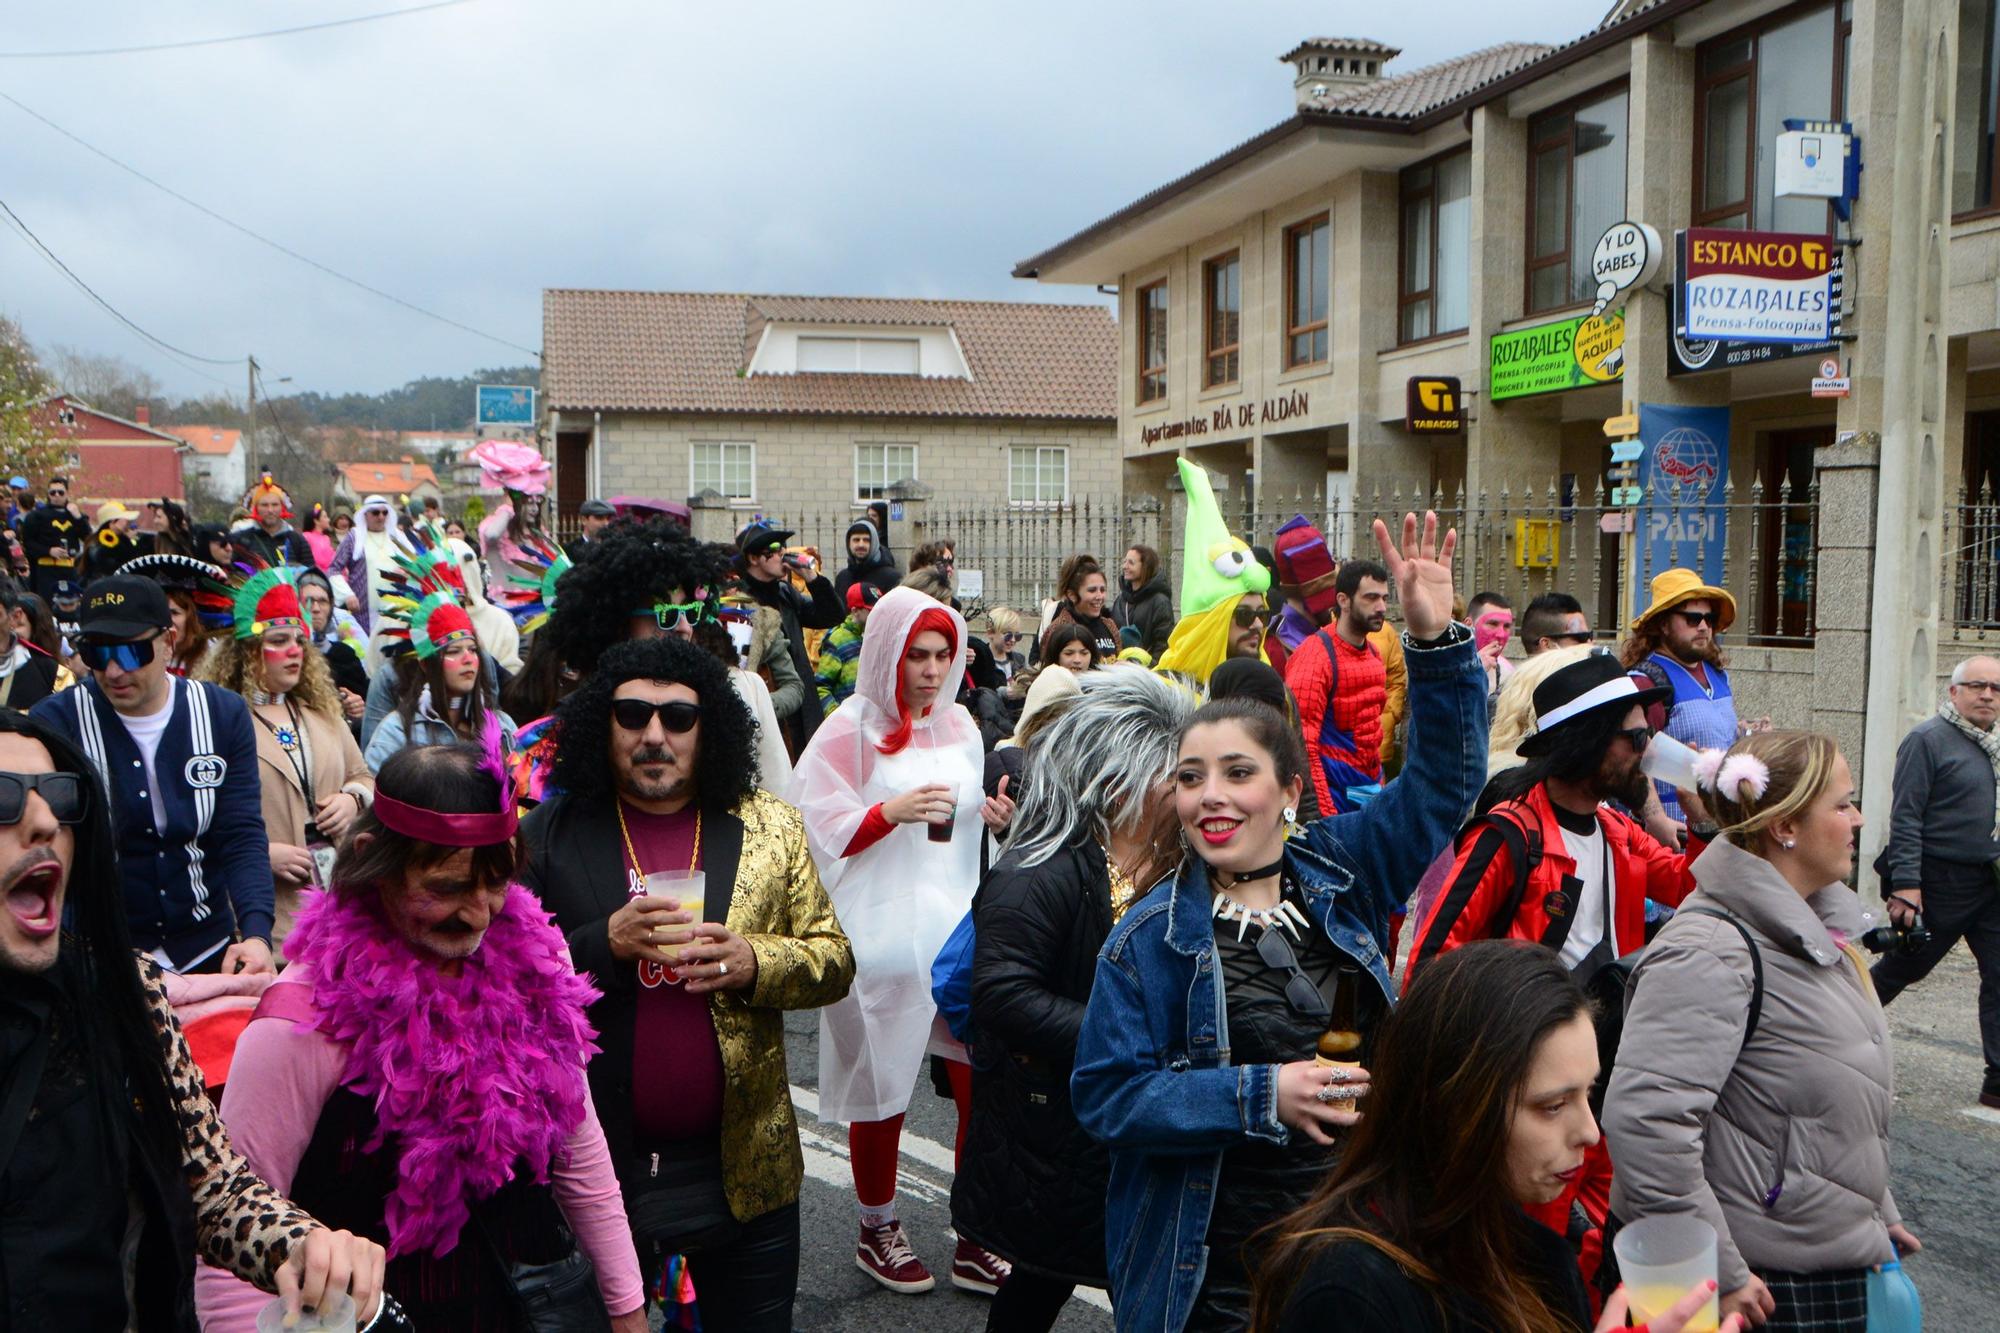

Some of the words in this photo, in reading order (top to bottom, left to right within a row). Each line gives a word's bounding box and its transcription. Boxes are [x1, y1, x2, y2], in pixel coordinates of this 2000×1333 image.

[1605, 235, 1612, 251] Y
[1617, 230, 1635, 248] LO
[1693, 240, 1798, 268] ESTANCO
[1692, 285, 1825, 314] ROZABALES
[1585, 320, 1600, 332] Tu
[1493, 328, 1571, 366] ROZABALES
[1535, 375, 1566, 387] PREMIOS
[1141, 415, 1208, 447] Apartamentos
[1213, 403, 1233, 431] RÍA
[1239, 403, 1254, 427] DE
[1261, 388, 1308, 424] ALDÁN
[1413, 420, 1459, 429] TABACOS
[1650, 512, 1716, 542] PADI
